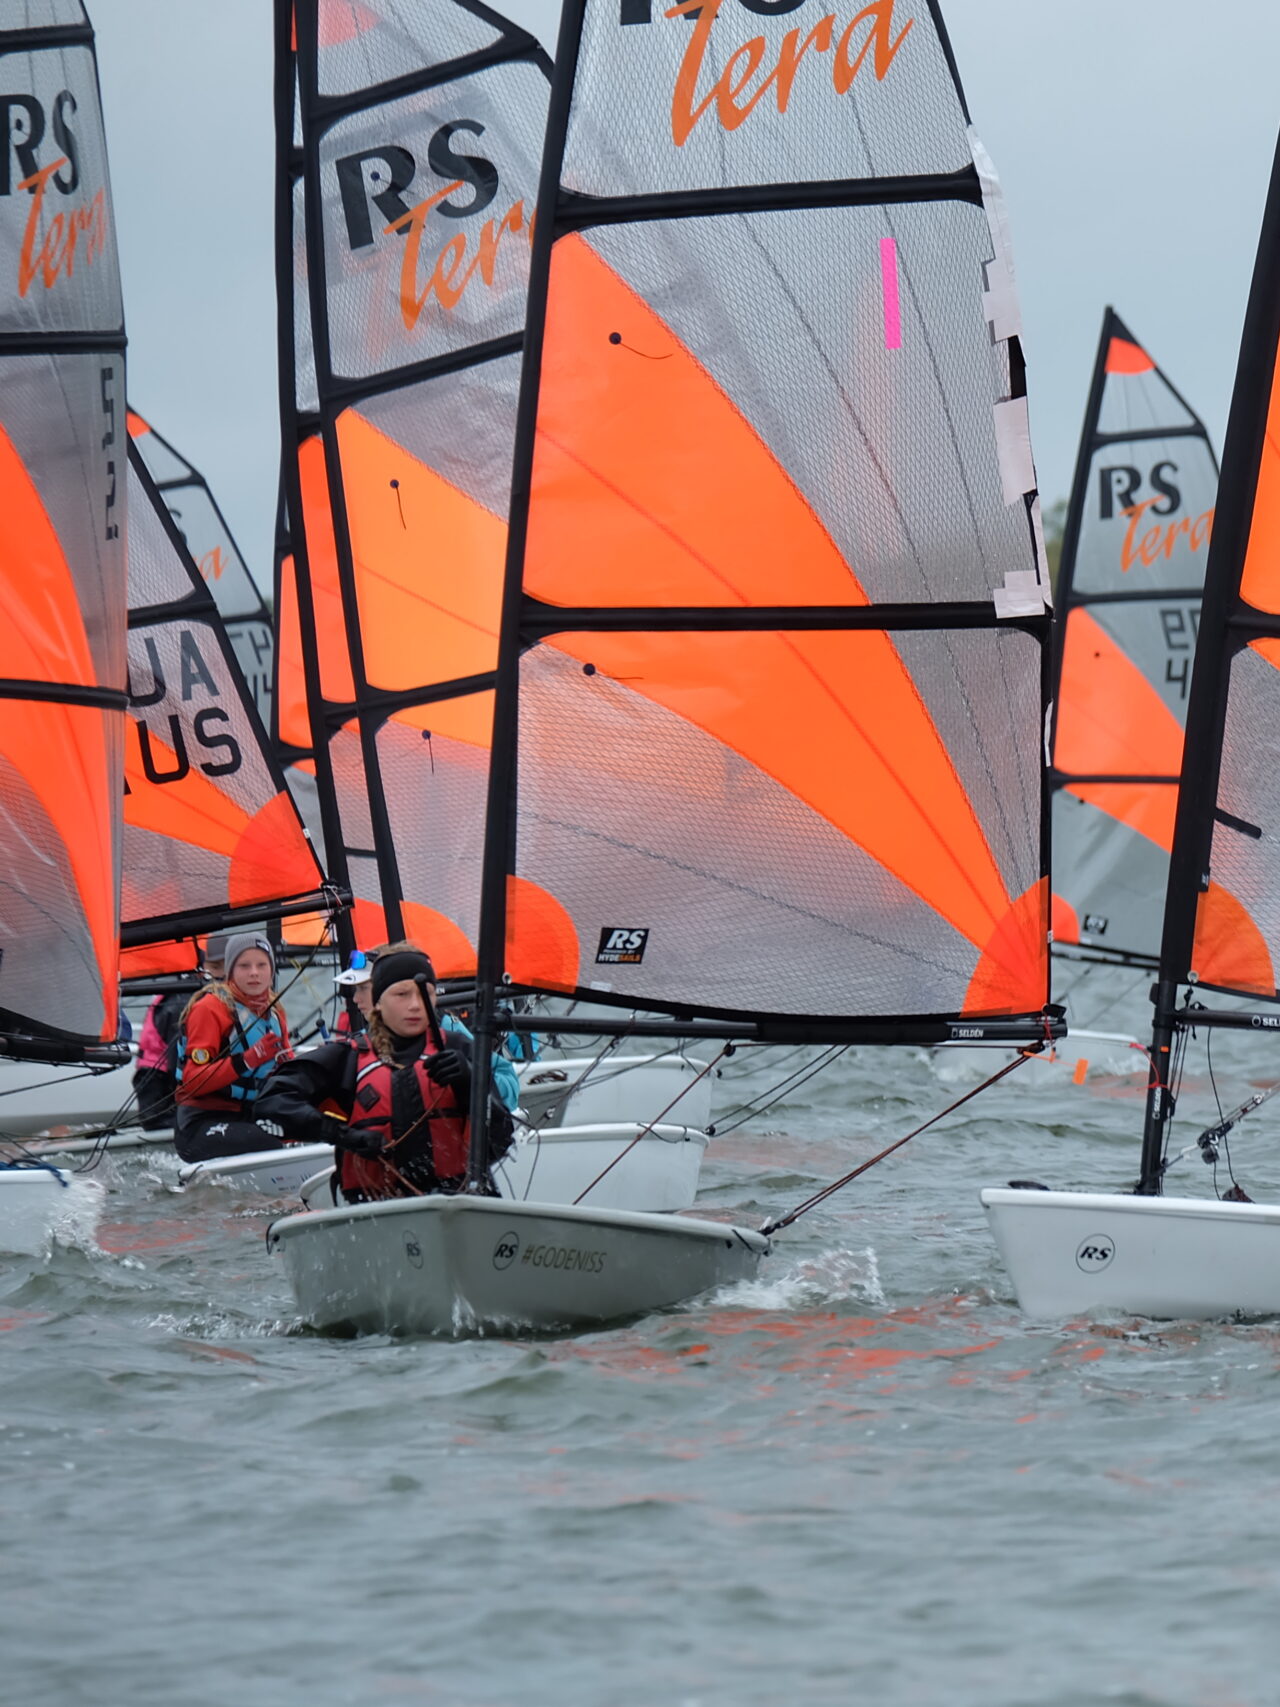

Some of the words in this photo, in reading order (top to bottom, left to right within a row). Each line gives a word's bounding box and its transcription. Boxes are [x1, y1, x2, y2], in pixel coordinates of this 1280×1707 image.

[664, 0, 914, 147] Tera
[0, 90, 78, 195] RS
[335, 119, 498, 250] RS
[383, 180, 537, 331] Ter
[1099, 460, 1181, 520] RS
[606, 929, 646, 949] RS
[406, 1242, 421, 1258] RS
[494, 1243, 518, 1259] RS
[521, 1243, 608, 1274] #GODENISS
[1080, 1246, 1111, 1261] RS
